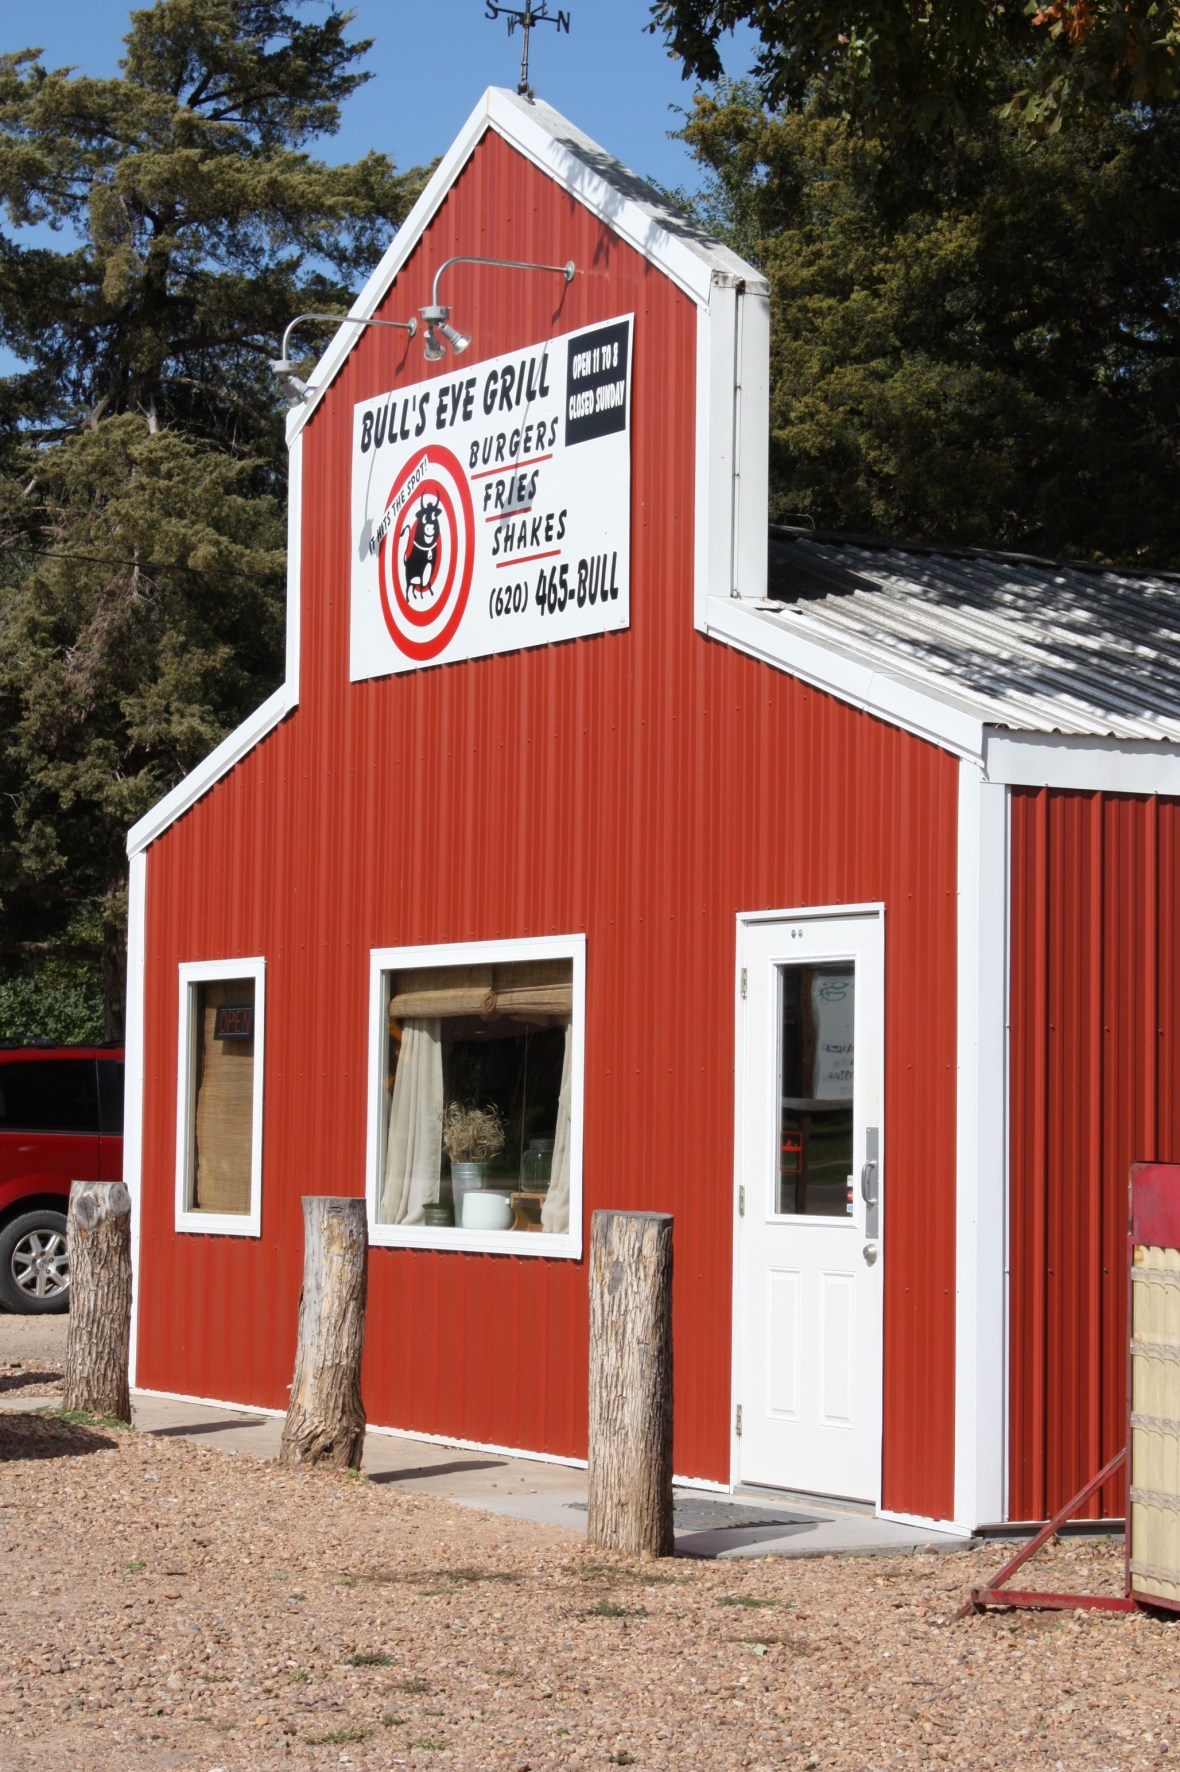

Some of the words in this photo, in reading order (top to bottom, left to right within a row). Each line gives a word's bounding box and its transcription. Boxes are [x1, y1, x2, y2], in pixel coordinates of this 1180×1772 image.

[572, 350, 592, 380] OPEN
[593, 347, 600, 374] 11
[601, 344, 612, 371] TO
[612, 341, 619, 368] 8
[360, 391, 431, 454] BULL'S
[435, 376, 477, 430] EYE
[482, 353, 551, 416] GRILL
[568, 389, 595, 421] CLOSED
[595, 379, 625, 413] SUNDAY
[468, 416, 559, 469] BURGERS
[368, 535, 376, 555] IT
[376, 511, 392, 543] HITS
[391, 489, 406, 518] THE
[406, 458, 428, 497] SPOT!
[483, 469, 540, 512] FRIES
[491, 509, 568, 556] SHAKES
[488, 581, 529, 620] (620)
[535, 551, 619, 616] 465-BULL
[219, 1010, 252, 1033] OPEN
